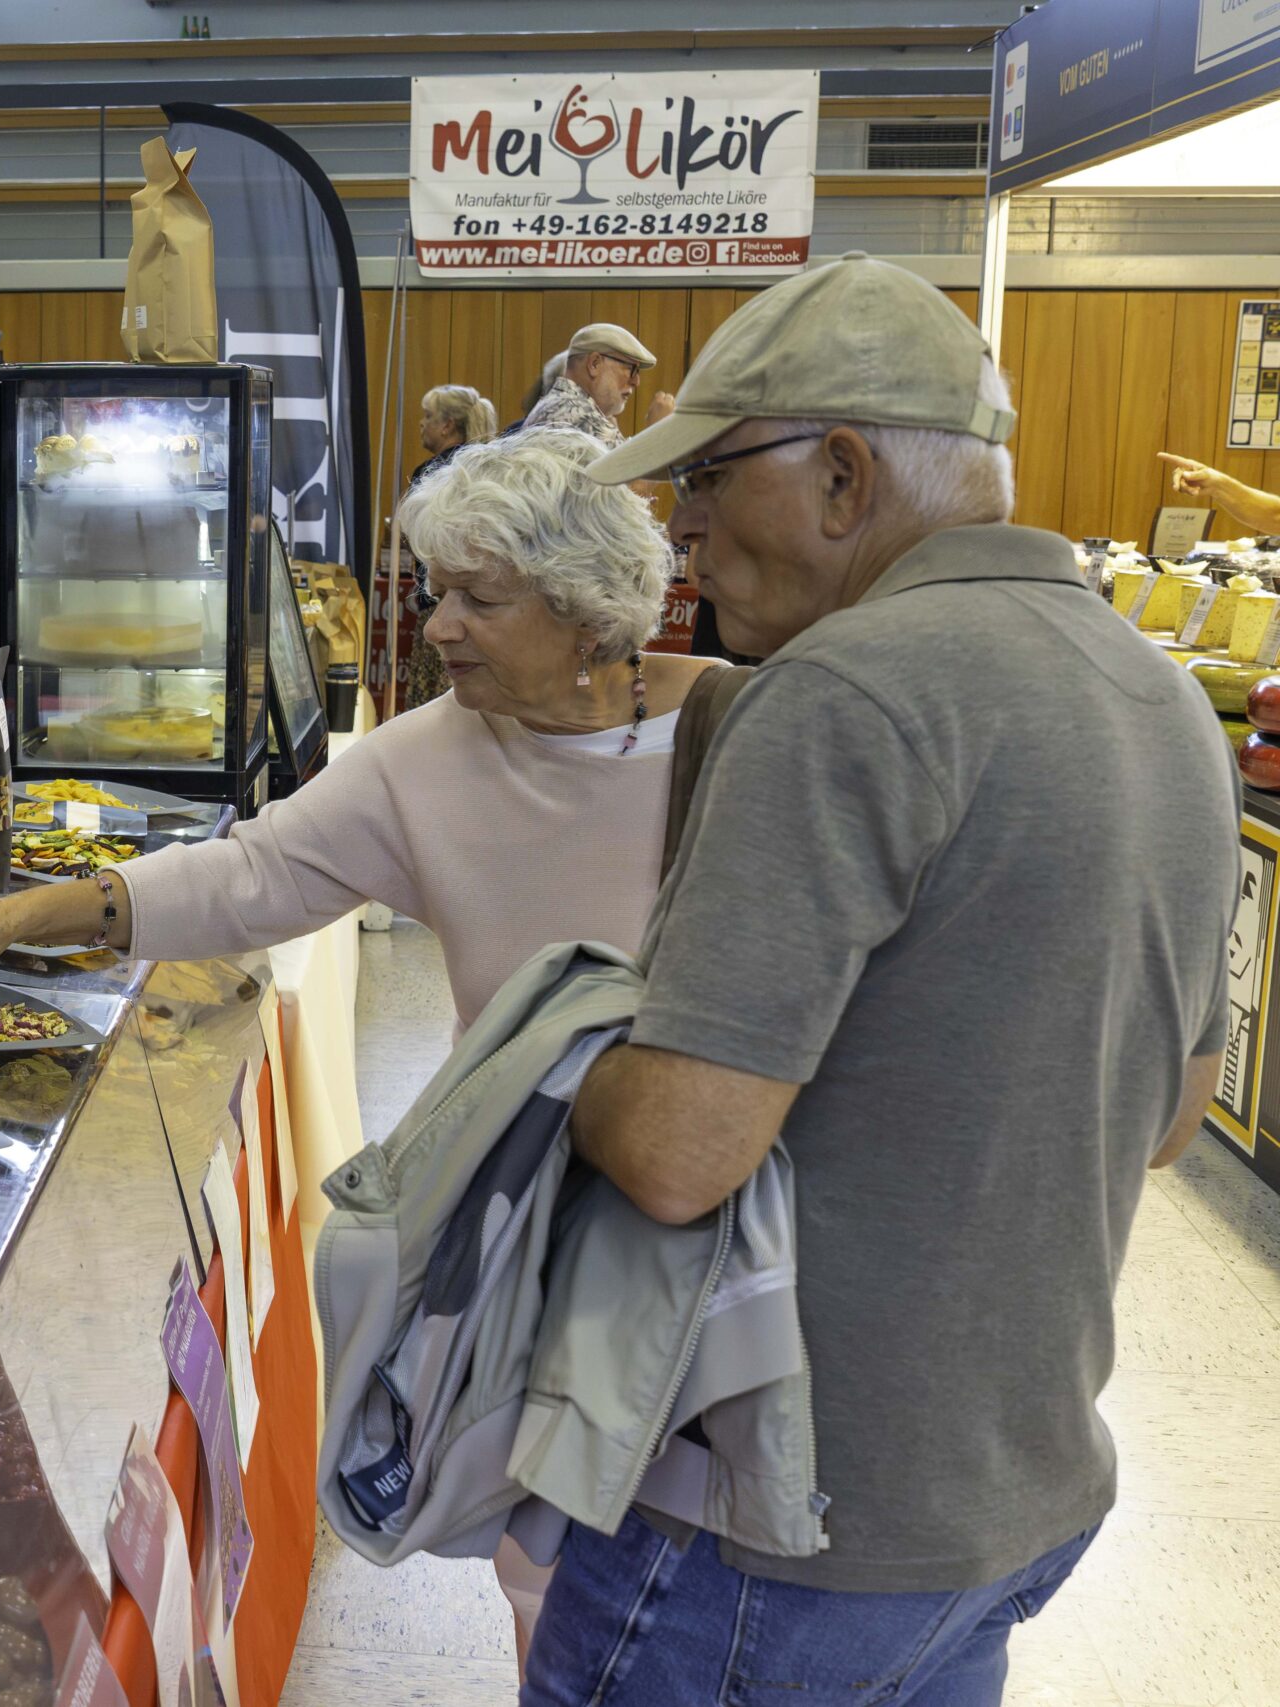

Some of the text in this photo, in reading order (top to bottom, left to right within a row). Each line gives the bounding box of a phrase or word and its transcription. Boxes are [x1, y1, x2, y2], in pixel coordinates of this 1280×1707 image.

[1059, 63, 1078, 97] VOM
[1079, 47, 1110, 87] GUTEN
[432, 96, 804, 191] Mei Likör
[455, 190, 768, 210] Manufaktur für selbstgemachte Liköre
[453, 212, 769, 236] fon +49-162-8149218
[420, 240, 684, 266] www.mei-likoer.de
[742, 241, 759, 251] Find
[760, 243, 772, 251] us
[772, 243, 783, 251] on
[742, 249, 800, 264] Facebook
[373, 1457, 412, 1499] NEW
